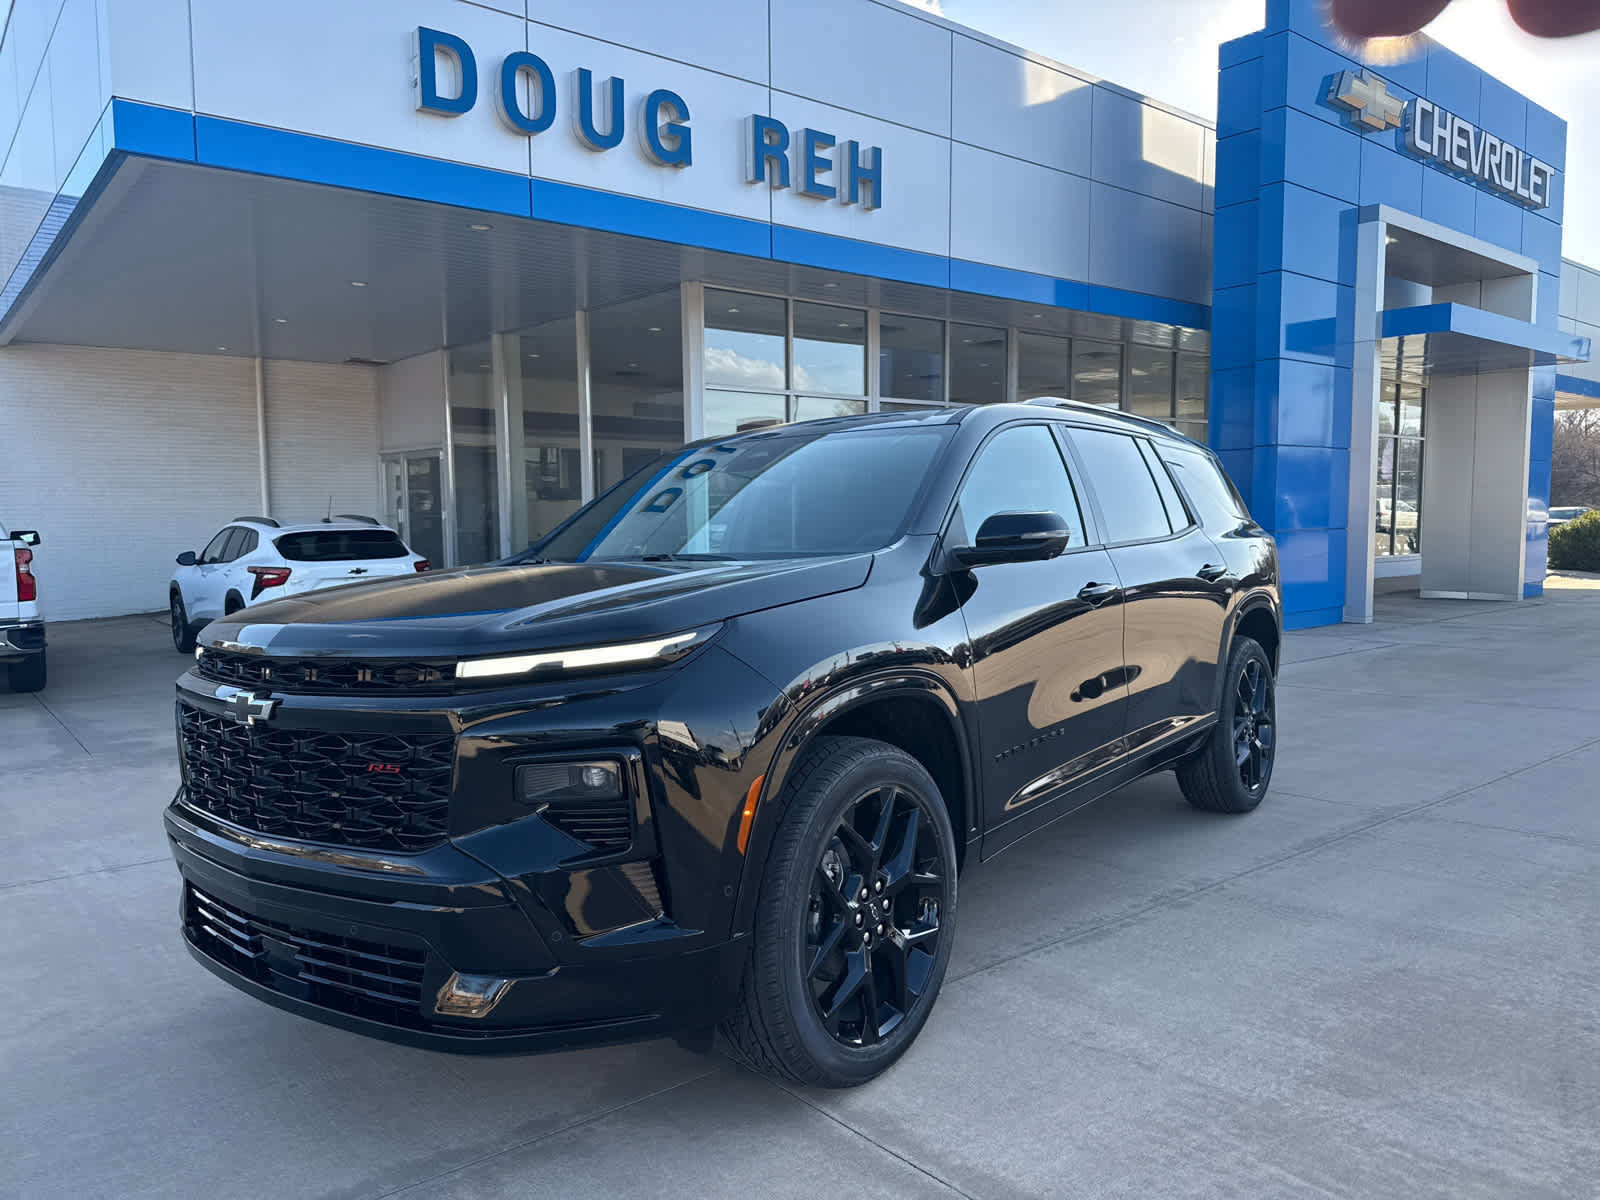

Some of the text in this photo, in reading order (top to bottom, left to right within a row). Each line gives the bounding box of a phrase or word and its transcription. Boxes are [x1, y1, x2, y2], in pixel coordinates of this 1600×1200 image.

[413, 26, 883, 210] DOUG REH
[1414, 97, 1555, 208] CHEVROLET
[367, 763, 401, 774] RS
